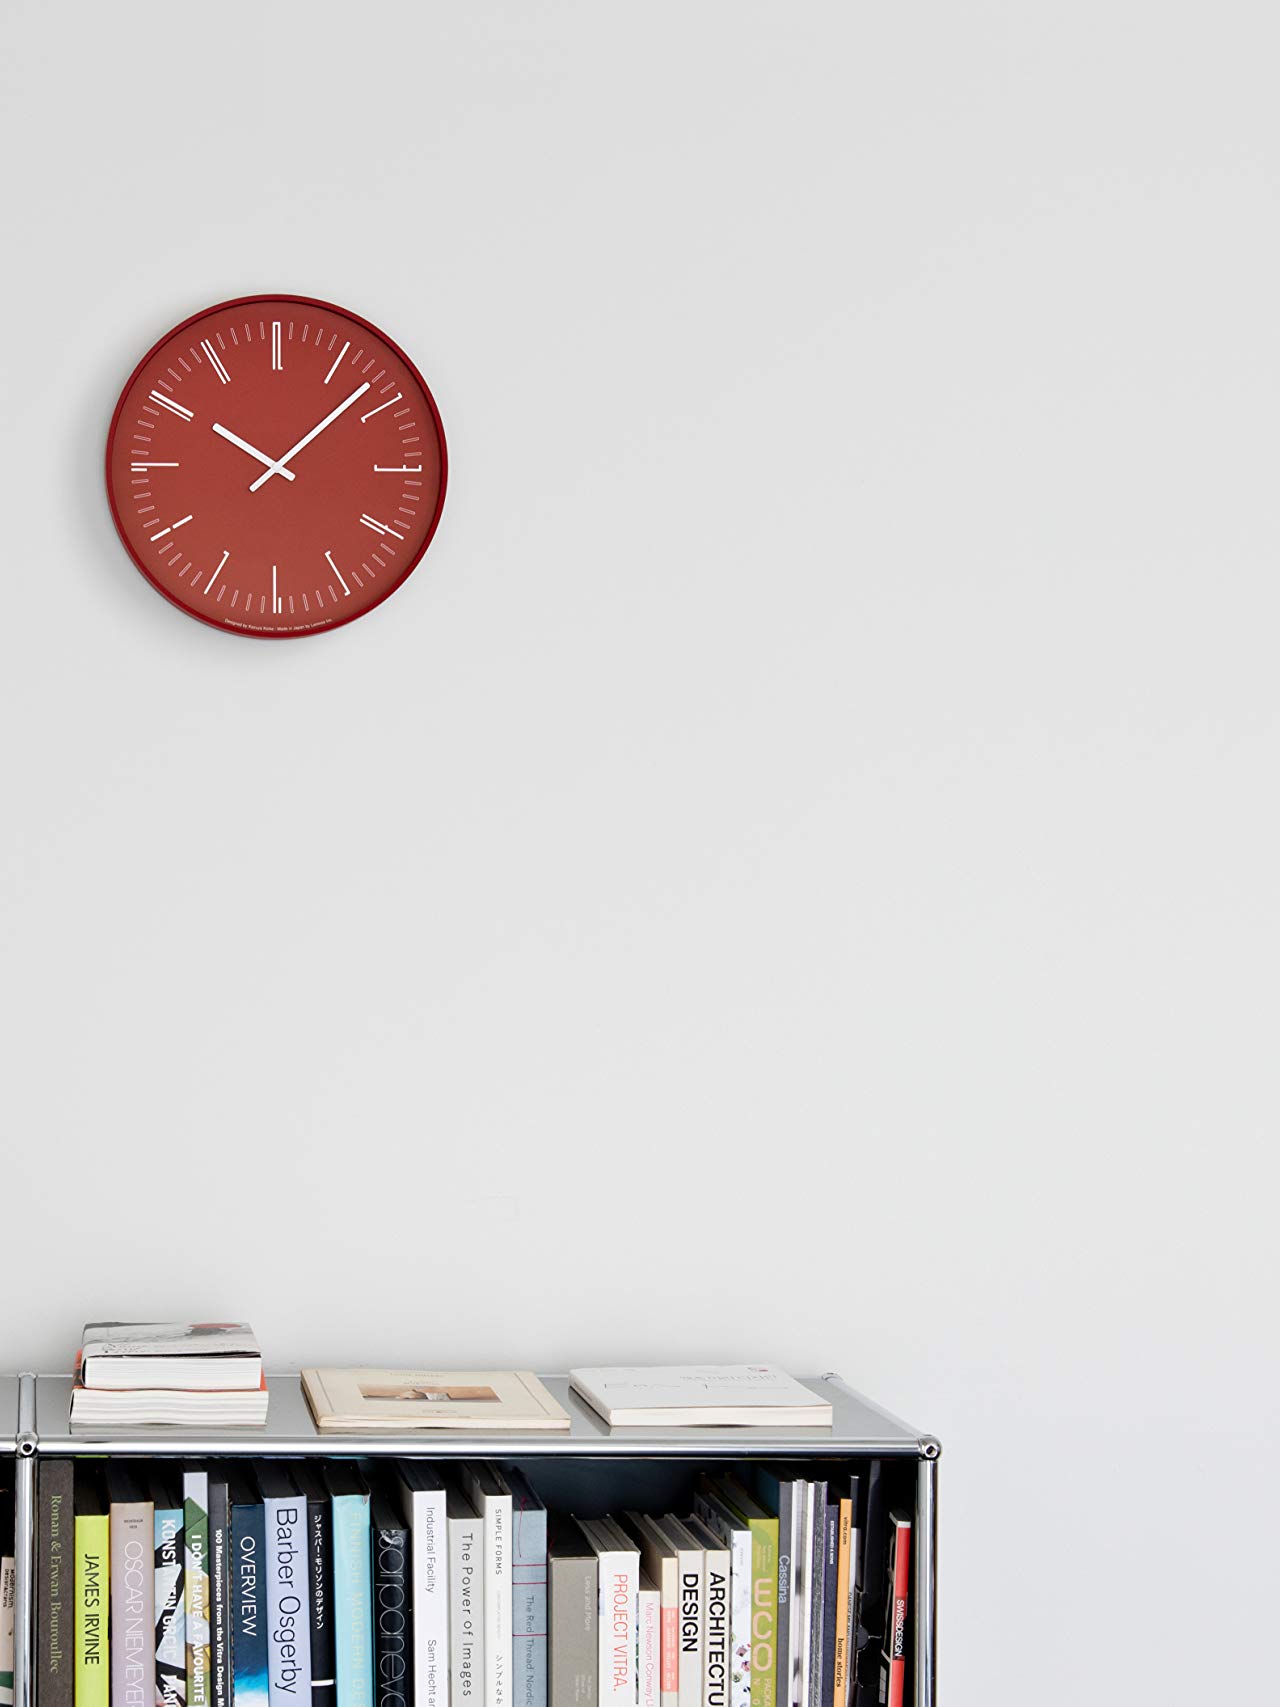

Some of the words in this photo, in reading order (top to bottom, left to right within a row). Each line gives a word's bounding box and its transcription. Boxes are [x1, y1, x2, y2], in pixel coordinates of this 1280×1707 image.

[50, 1495, 62, 1538] Ronan
[426, 1507, 435, 1556] Industrial
[51, 1541, 61, 1552] &
[276, 1508, 299, 1588] Barber
[462, 1533, 474, 1562] The
[495, 1544, 503, 1575] FORMS
[50, 1555, 62, 1599] Erwan
[85, 1553, 100, 1608] JAMES
[124, 1541, 144, 1616] OSCAR
[215, 1545, 223, 1603] Masterpieces
[240, 1536, 257, 1636] OVERVIEW
[425, 1557, 436, 1594] Facility
[462, 1567, 474, 1616] Power
[584, 1575, 592, 1595] Less
[778, 1555, 790, 1604] Cassina
[192, 1584, 203, 1617] HAVE
[526, 1595, 535, 1613] The
[584, 1595, 592, 1611] and
[613, 1574, 628, 1641] PROJECT
[645, 1602, 654, 1624] Marc
[682, 1573, 699, 1652] DESIGN
[50, 1602, 63, 1674] Bouroullec
[84, 1612, 100, 1665] IRVINE
[192, 1621, 203, 1630] A
[216, 1627, 224, 1641] the
[463, 1621, 474, 1638] of
[526, 1616, 535, 1633] Red
[584, 1611, 592, 1632] More
[708, 1571, 726, 1706] ARCHITECTU
[752, 1578, 773, 1672] ECO
[894, 1599, 905, 1657] SWISSDESIGN
[216, 1642, 224, 1664] Vitra
[273, 1596, 303, 1694] Osgerby
[427, 1639, 437, 1662] Sam
[645, 1626, 654, 1661] Newson
[836, 1638, 845, 1660] home
[192, 1634, 204, 1703] FAVOURITE
[215, 1666, 225, 1695] Design
[427, 1665, 437, 1695] Hecht
[460, 1643, 474, 1696] Images
[613, 1644, 628, 1692] VITRA.
[644, 1662, 654, 1697] Conway
[836, 1661, 844, 1688] stories
[526, 1675, 535, 1705] Nordic
